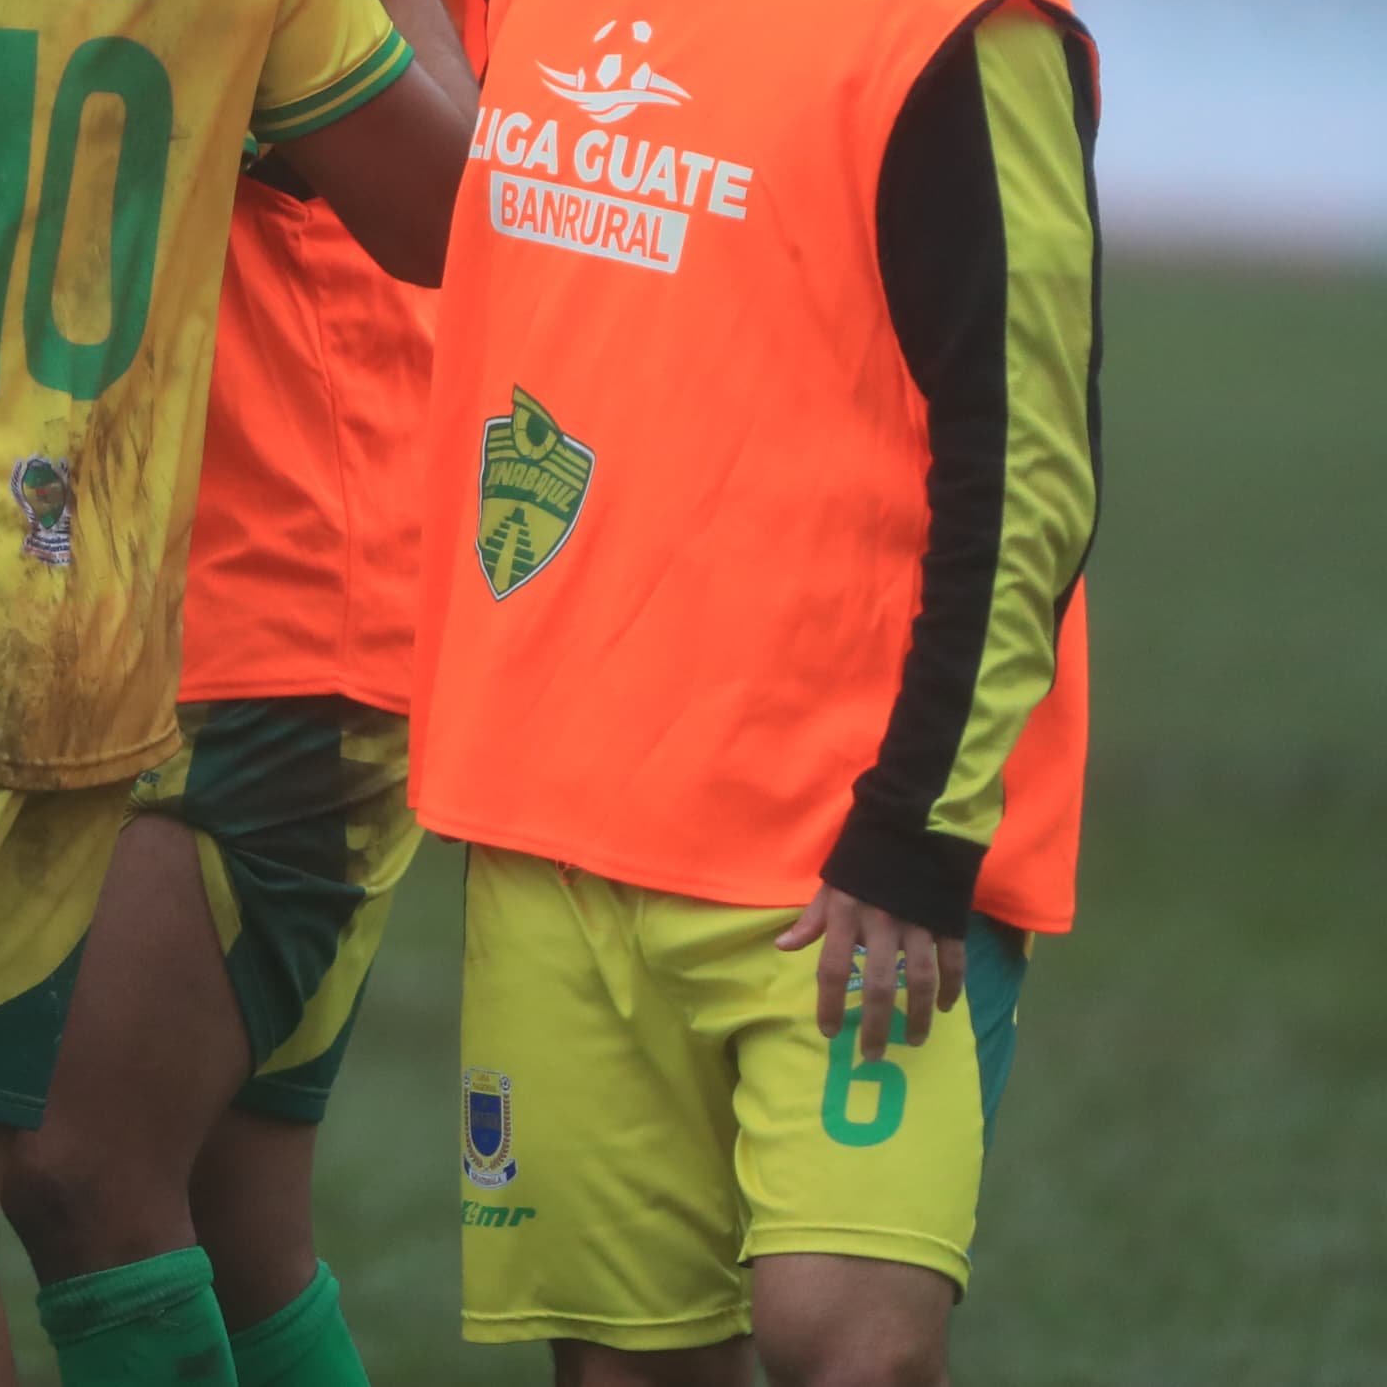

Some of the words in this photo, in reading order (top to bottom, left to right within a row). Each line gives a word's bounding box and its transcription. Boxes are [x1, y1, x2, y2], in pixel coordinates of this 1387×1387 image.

[469, 107, 558, 174] LIGA
[574, 129, 753, 220] GUATE
[501, 181, 670, 262] BANRURAL
[822, 1005, 907, 1147] 6
